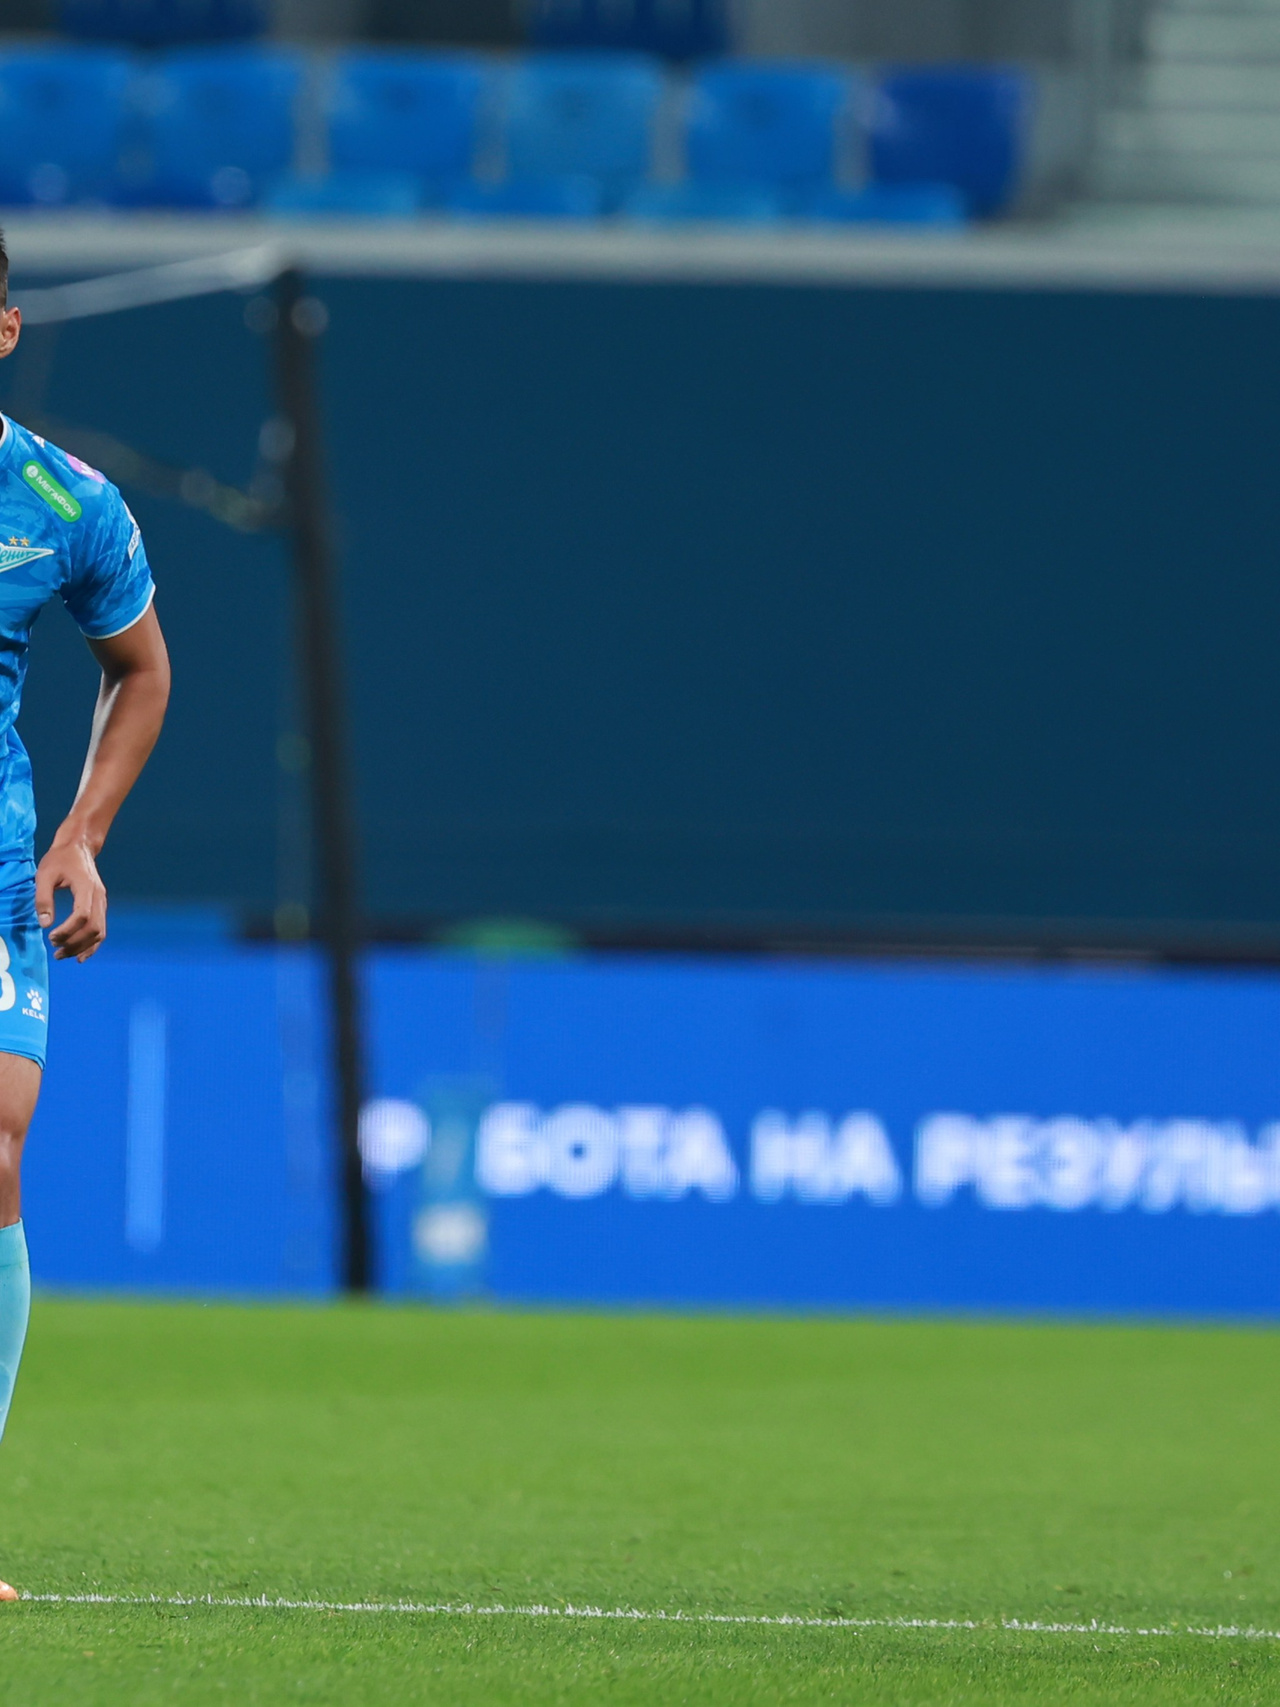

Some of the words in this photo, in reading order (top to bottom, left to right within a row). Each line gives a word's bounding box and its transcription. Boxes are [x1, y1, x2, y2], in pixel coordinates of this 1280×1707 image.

[35, 475, 78, 518] МЕГАФОН
[357, 1098, 740, 1202] РБОТА
[748, 1108, 904, 1207] НА
